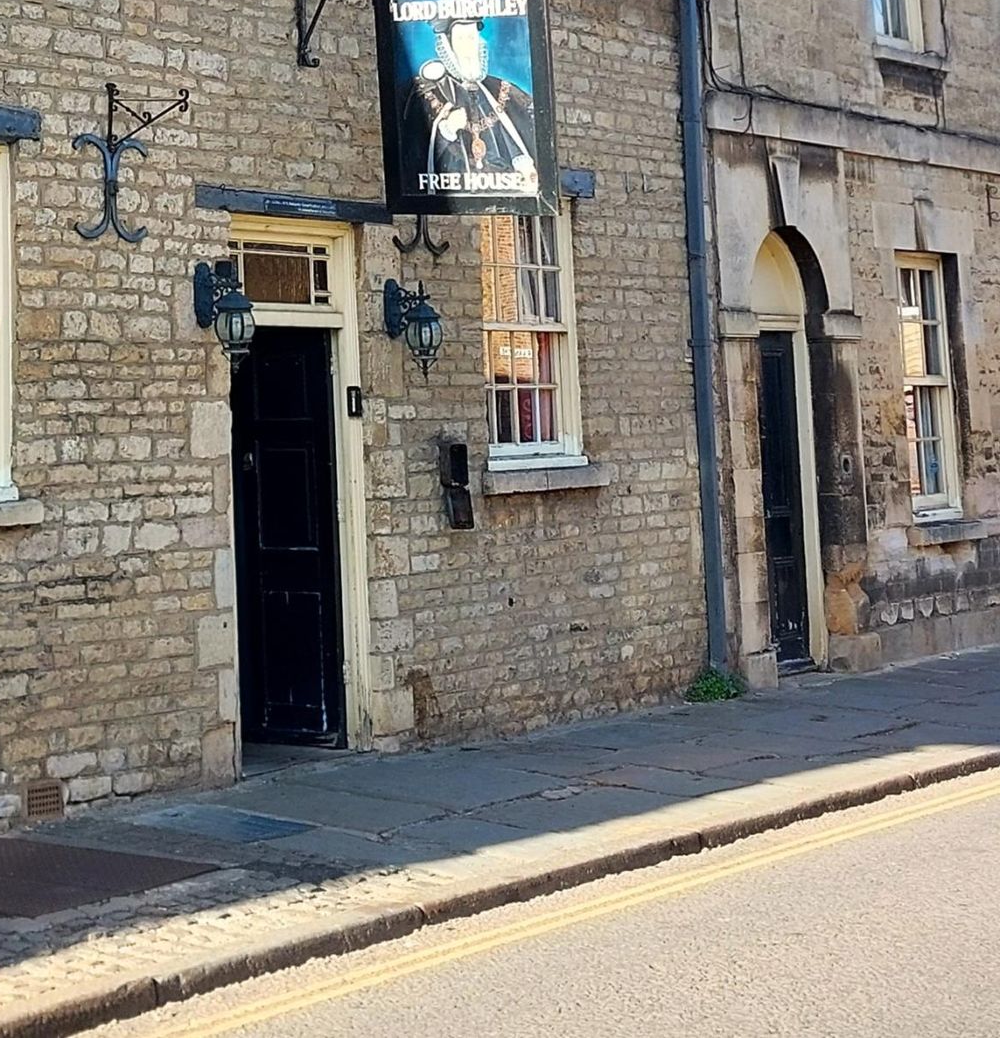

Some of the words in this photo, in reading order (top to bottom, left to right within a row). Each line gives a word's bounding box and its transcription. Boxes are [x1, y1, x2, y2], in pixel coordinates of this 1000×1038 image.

[393, 1, 437, 21] LORD
[419, 173, 462, 190] FREE
[464, 173, 525, 190] HOUSE
